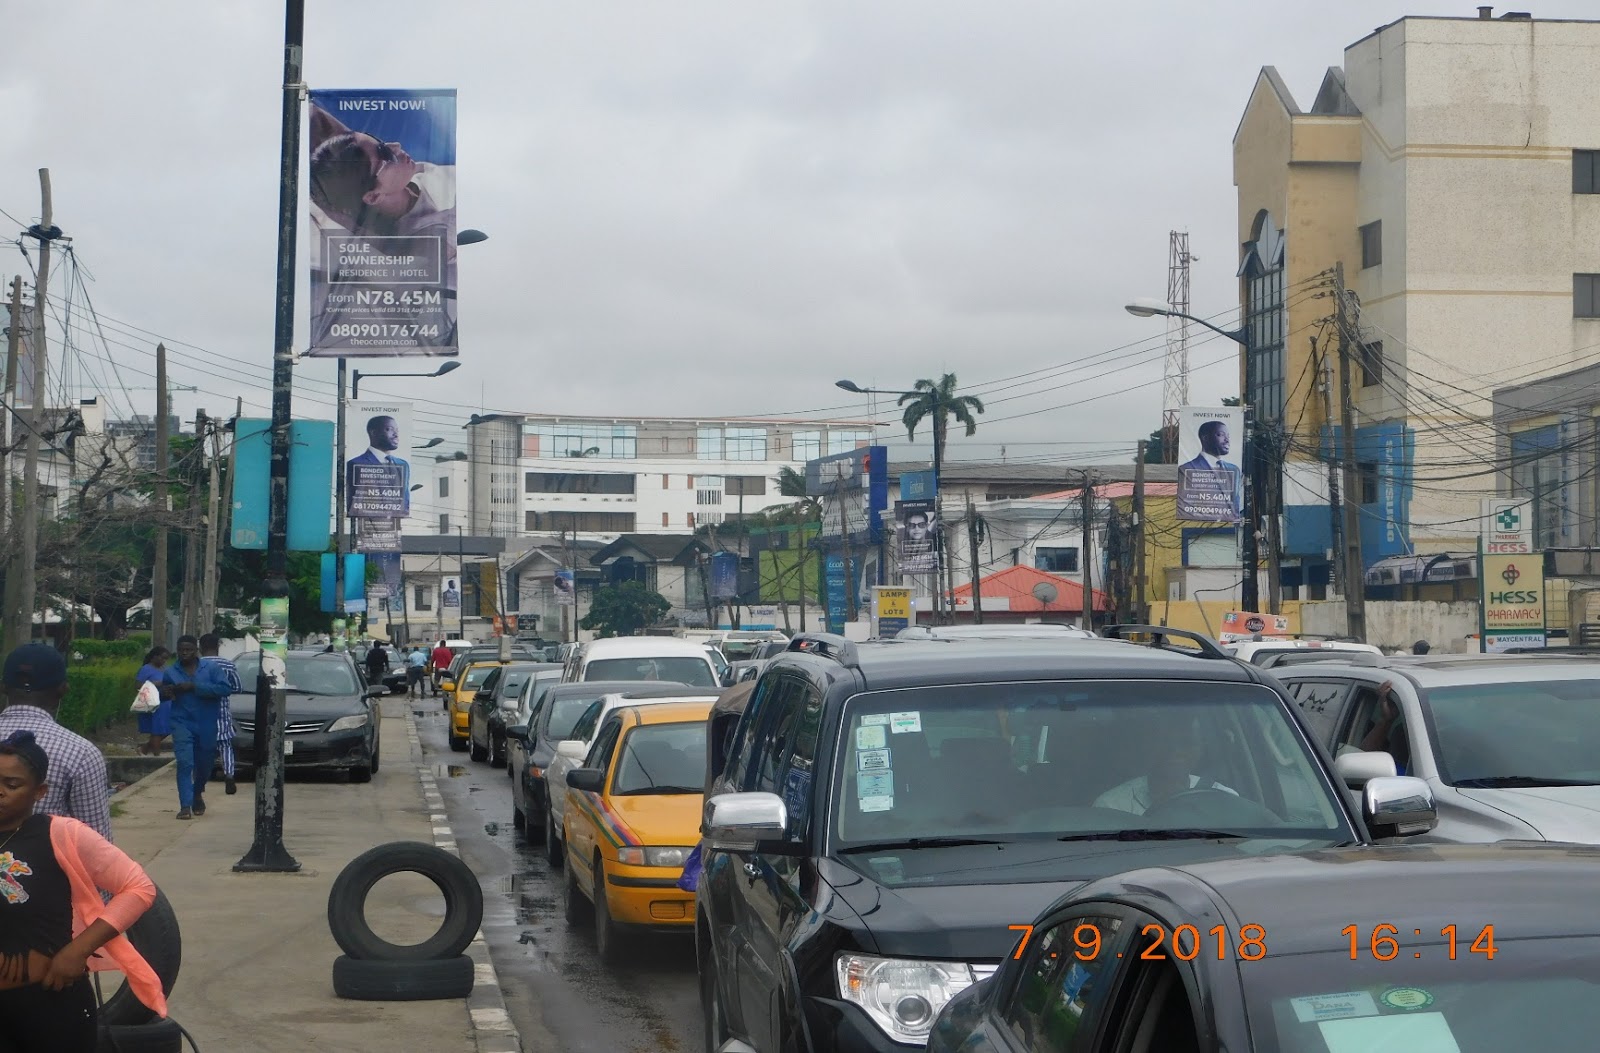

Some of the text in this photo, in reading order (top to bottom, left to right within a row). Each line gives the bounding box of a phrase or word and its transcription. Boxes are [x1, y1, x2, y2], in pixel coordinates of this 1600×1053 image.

[339, 100, 426, 111] INVEST NOW!
[339, 243, 370, 253] SOLE
[339, 255, 415, 265] OWNERSHIP
[339, 269, 389, 277] RESIDENCE
[400, 269, 429, 277] HOTEL
[328, 290, 441, 305] from N78.45M
[330, 324, 439, 337] 08090176744
[350, 338, 418, 346] theoceanna.com
[368, 489, 401, 497] N5.40M
[1199, 493, 1231, 501] N5.40M
[1487, 543, 1528, 553] HESS
[1490, 591, 1538, 605] HESS
[1487, 609, 1541, 620] PHARMACY
